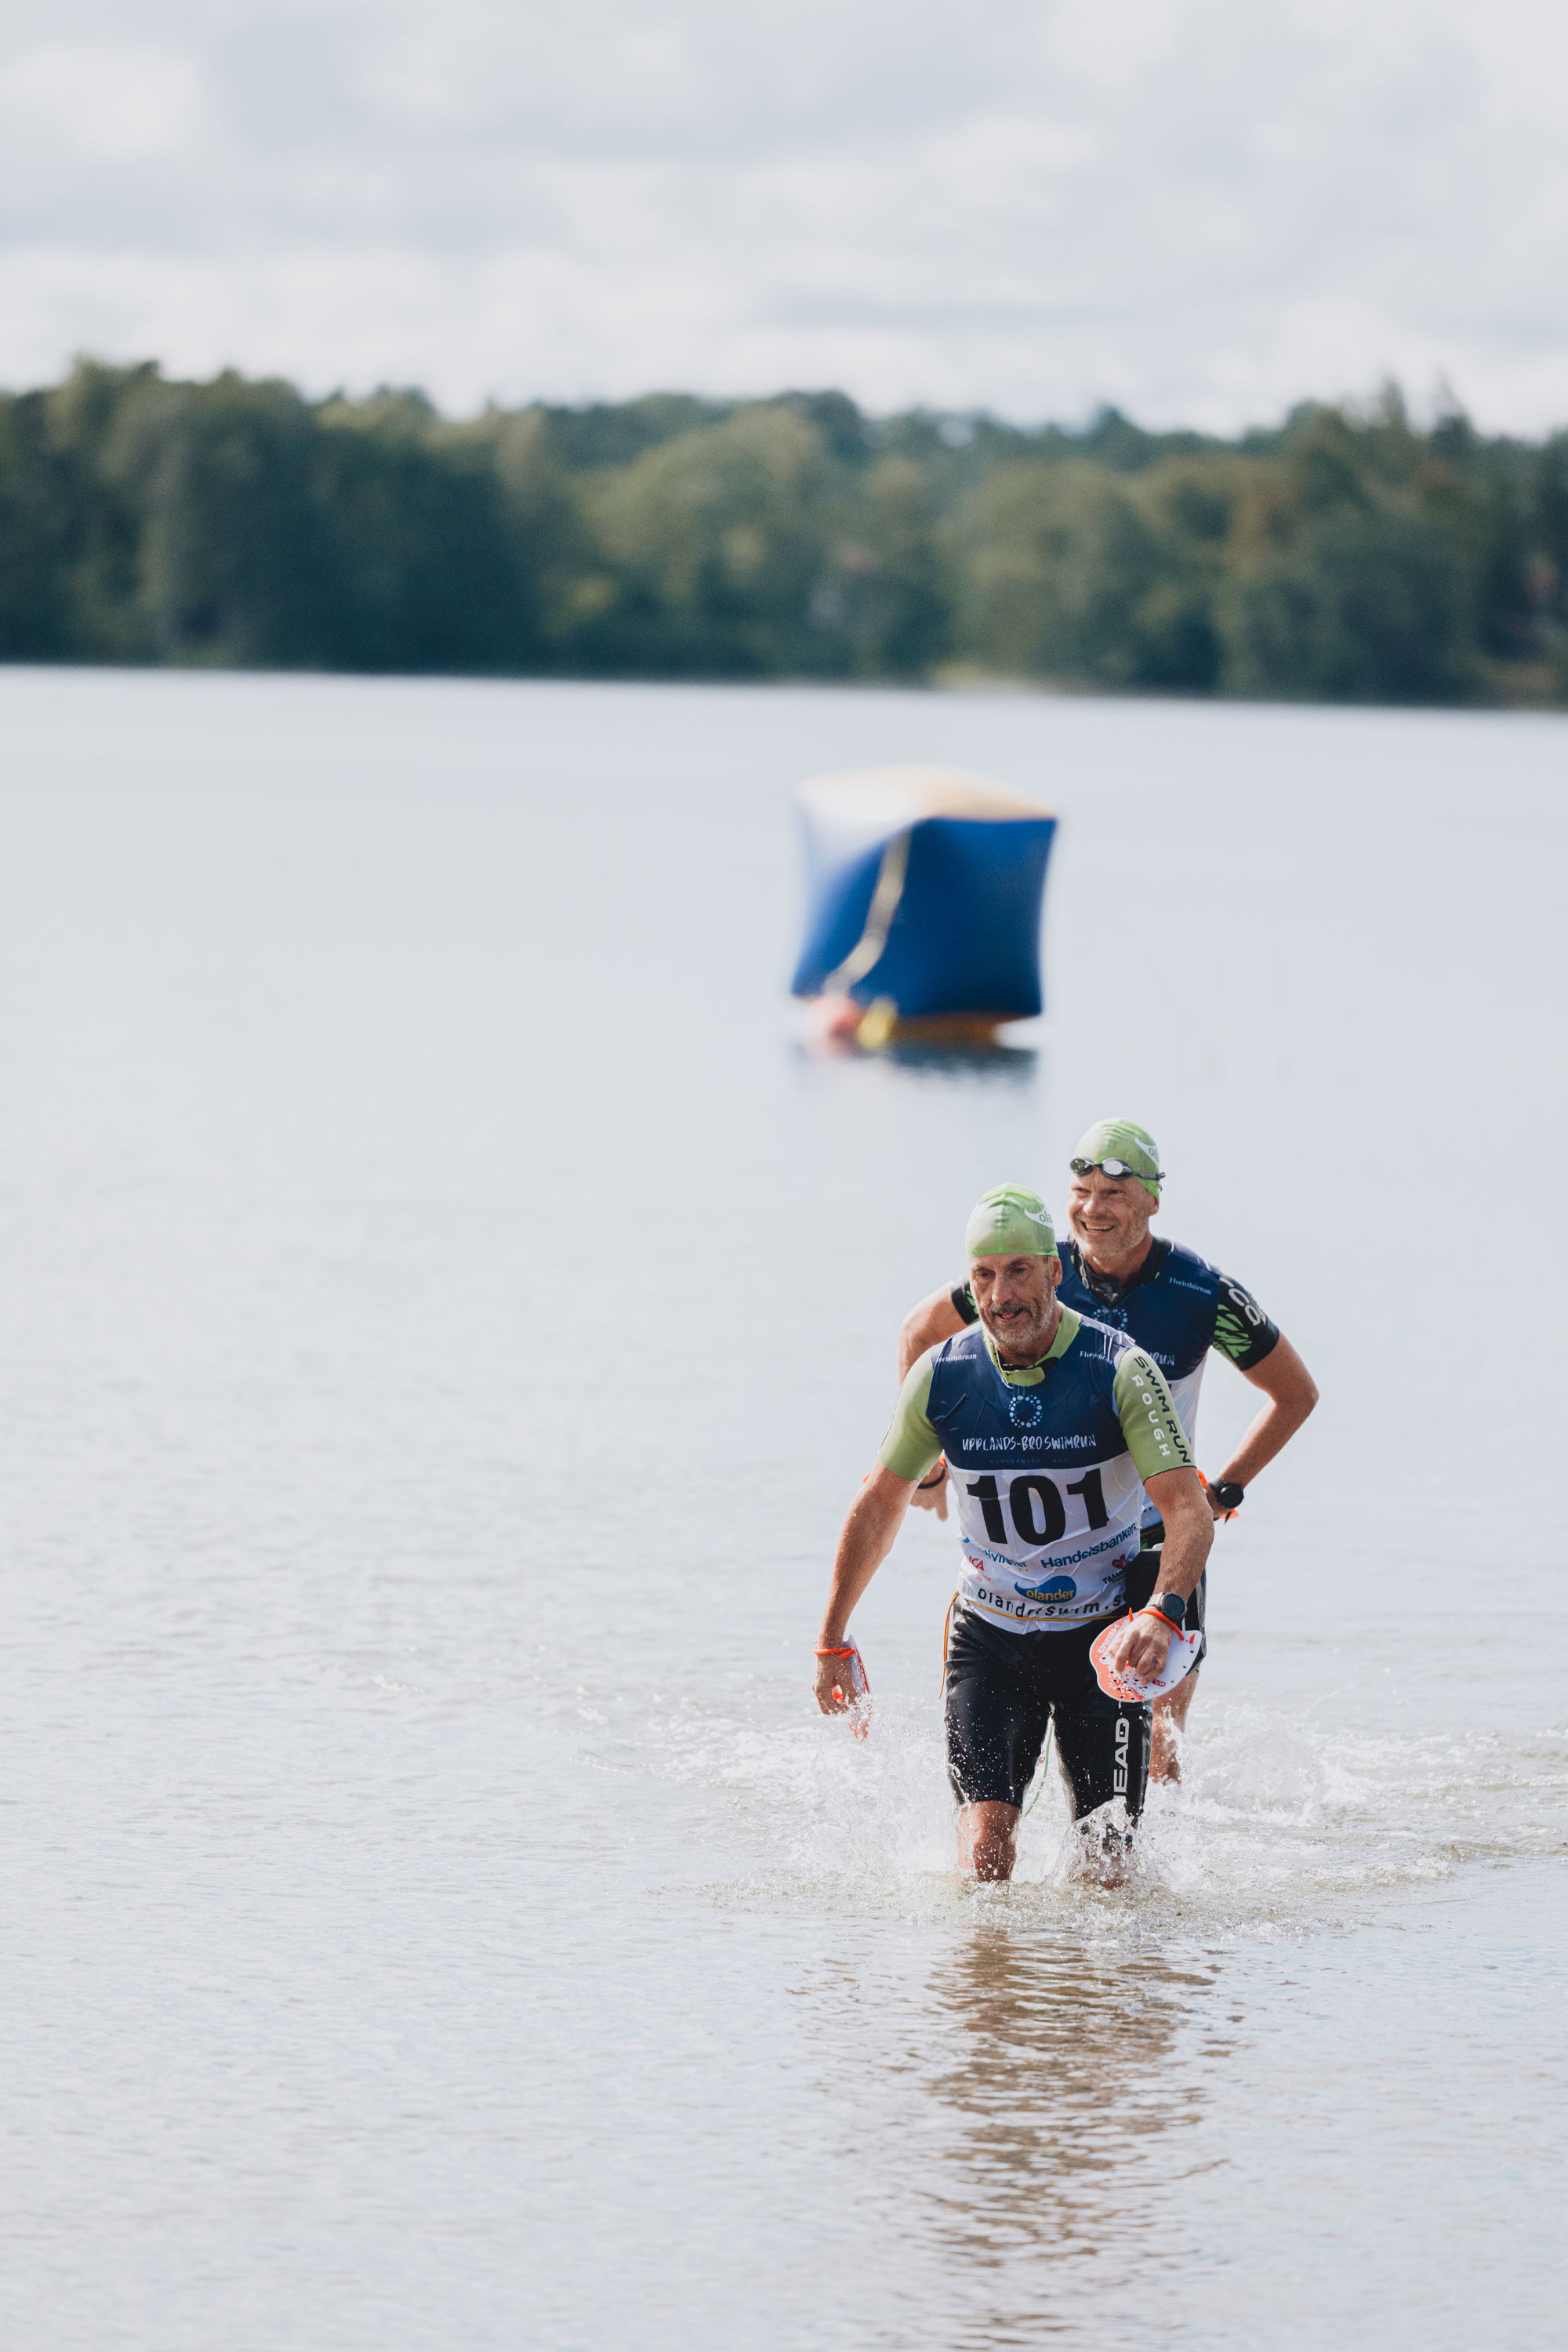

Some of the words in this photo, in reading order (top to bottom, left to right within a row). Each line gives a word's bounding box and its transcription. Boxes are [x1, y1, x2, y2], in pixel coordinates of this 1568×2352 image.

[1131, 1374, 1171, 1456] ROUGH
[1134, 1356, 1171, 1413] SWIM
[1166, 1420, 1191, 1463] RUN
[966, 1468, 1109, 1546] 101
[1040, 1523, 1137, 1569] Handelsbanken
[968, 1555, 985, 1571] ICA
[1025, 1588, 1075, 1601] olander
[1113, 1717, 1130, 1802] EAD
